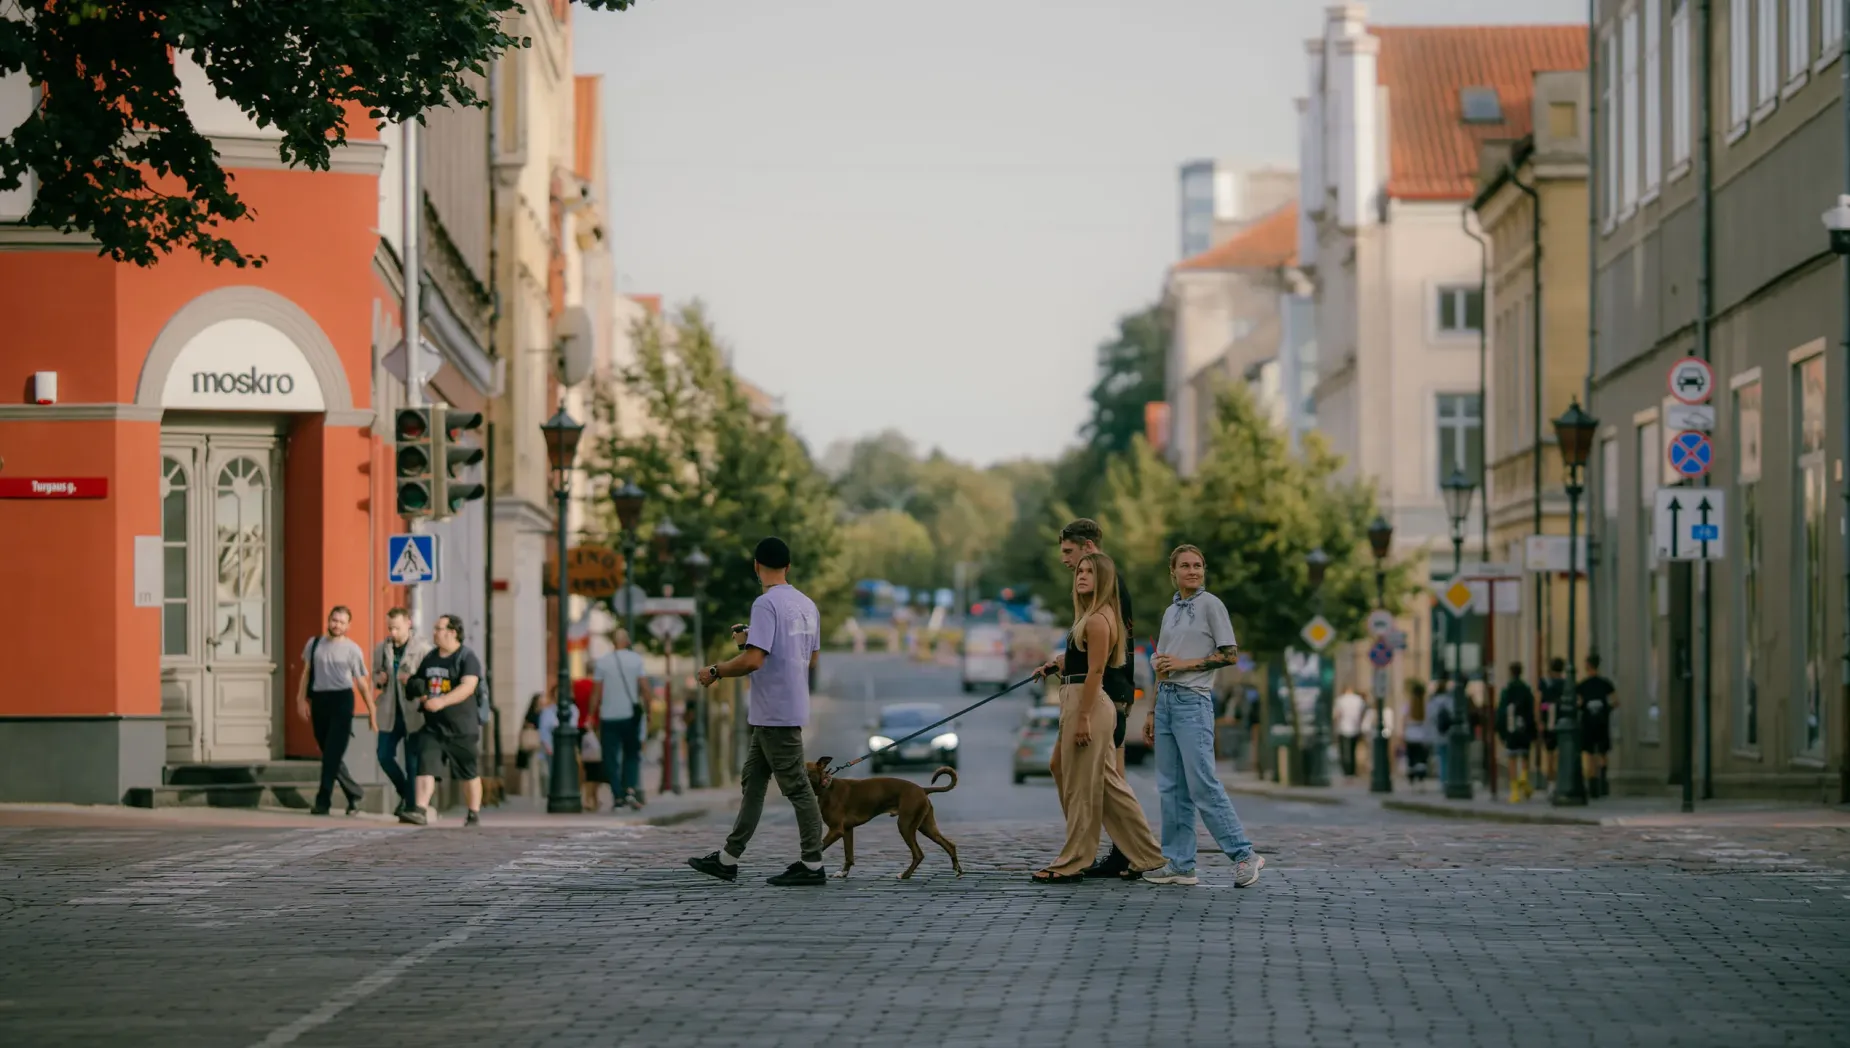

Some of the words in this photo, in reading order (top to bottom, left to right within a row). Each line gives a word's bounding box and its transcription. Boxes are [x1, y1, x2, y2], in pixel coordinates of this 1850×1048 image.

[192, 365, 294, 394] moskro
[32, 480, 67, 495] Turgaus
[67, 482, 77, 495] g.
[566, 550, 616, 571] INO
